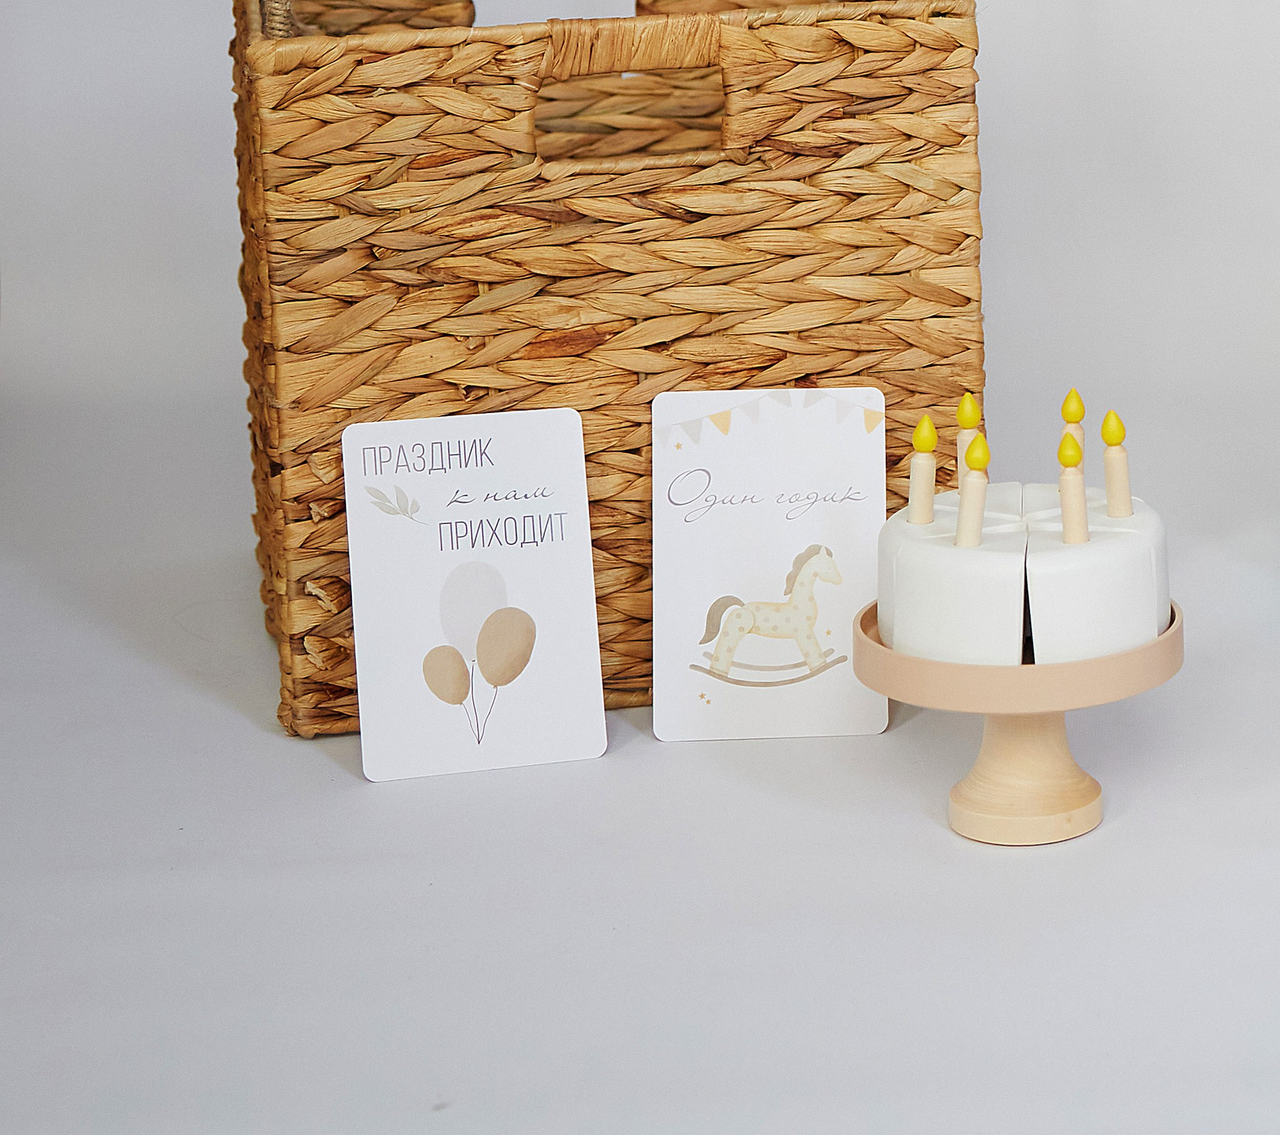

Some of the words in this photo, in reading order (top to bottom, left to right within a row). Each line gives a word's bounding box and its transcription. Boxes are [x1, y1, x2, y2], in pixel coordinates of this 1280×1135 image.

[362, 438, 495, 476] ПРАЗДНИК
[446, 489, 476, 507] к
[483, 486, 555, 503] нам
[667, 468, 764, 523] Один
[775, 486, 868, 521] годик
[438, 512, 568, 551] ПРИХОДИТ
